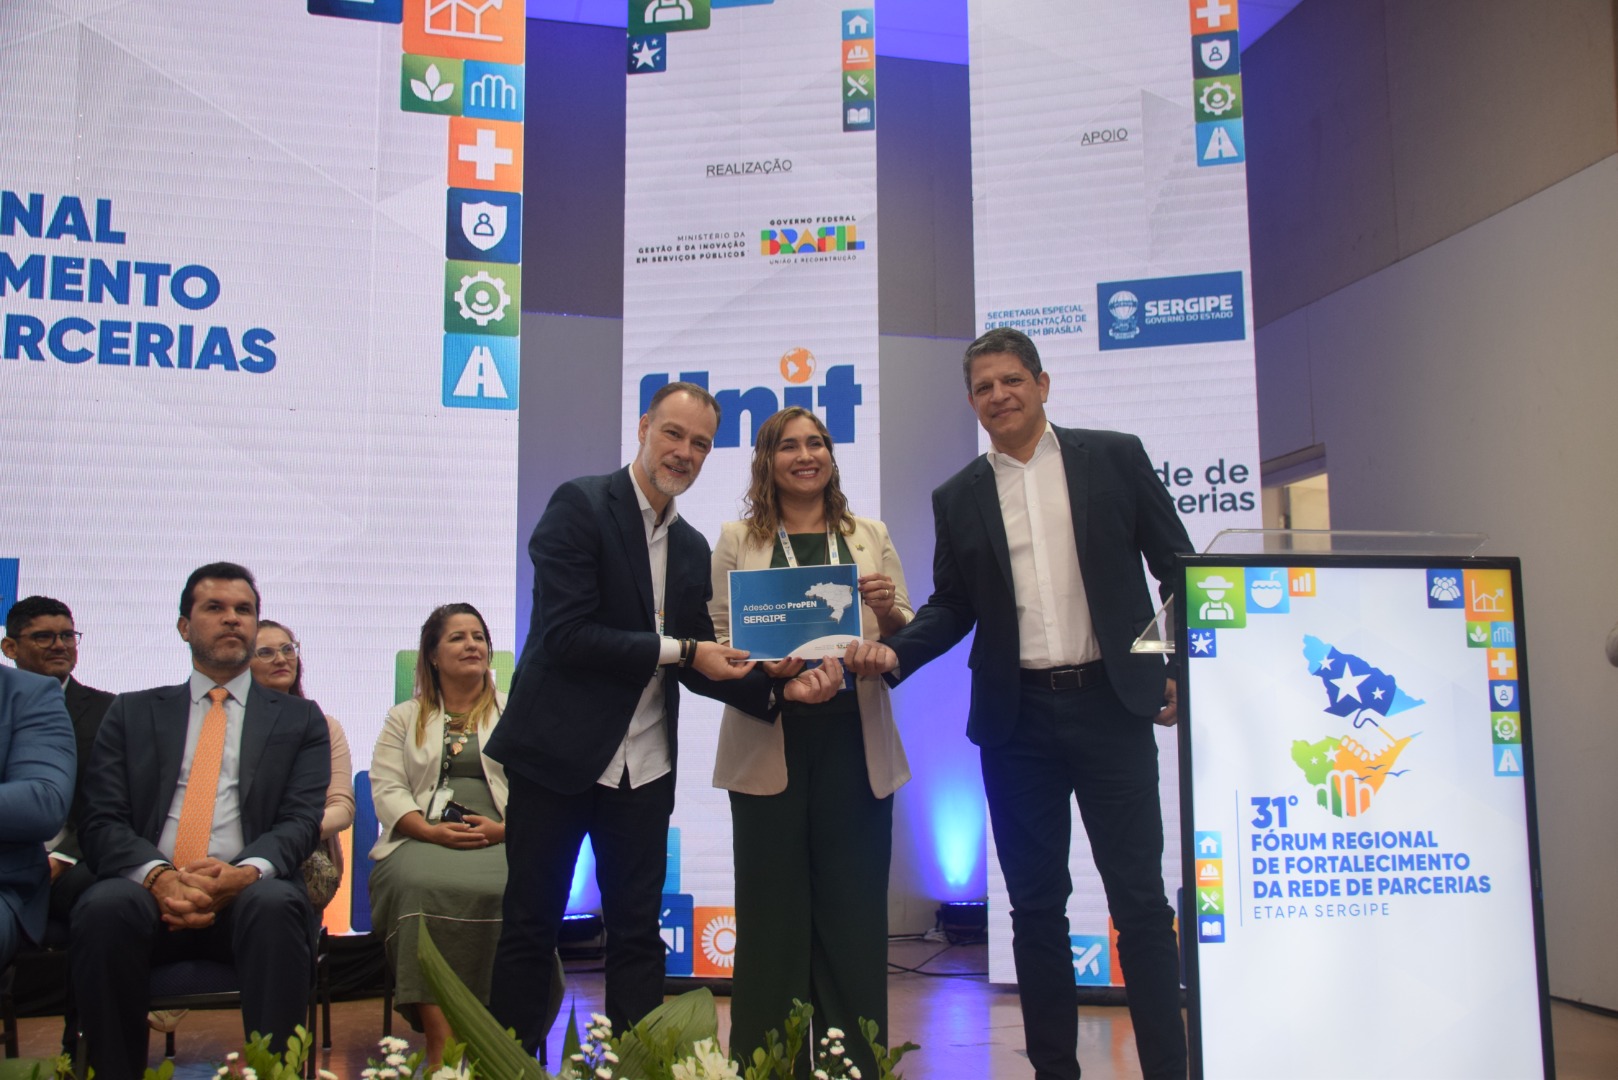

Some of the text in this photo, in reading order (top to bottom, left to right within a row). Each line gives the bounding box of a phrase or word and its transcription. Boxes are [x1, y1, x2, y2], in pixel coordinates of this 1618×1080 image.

[1081, 128, 1128, 146] APOIO
[706, 158, 792, 177] REALIZAÇÃO
[770, 218, 812, 226] GOVERNO
[677, 232, 730, 241] MINISTÉRIO
[761, 225, 865, 256] BRASIL
[638, 244, 672, 253] GESTÃO
[700, 240, 745, 249] INOVAÇÃO
[652, 254, 696, 262] SERVIÇOS
[700, 251, 745, 259] PÚBLICOS
[801, 255, 857, 263] RECONSTRUÇÃO
[987, 304, 1083, 319] SECRETARIA ESPECIAL
[1145, 295, 1233, 317] SERGIPE
[985, 322, 997, 330] DE
[1075, 314, 1087, 322] DE
[1145, 316, 1185, 325] GOVERNO
[1201, 311, 1233, 319] ESTADO
[1028, 329, 1040, 337] EM
[1043, 325, 1083, 336] BRASÍLIA
[0, 313, 277, 373] RCERIAS
[1205, 458, 1249, 485] de
[1171, 486, 1255, 514] erias
[743, 603, 773, 612] Adesão
[787, 601, 817, 609] ProPEN
[743, 614, 787, 624] SERGIPE
[1251, 829, 1438, 852] FÓRUM REGIONAL
[1252, 852, 1470, 875] DE FORTALECIMENTO
[1253, 875, 1491, 899] DA REDE DE PARCERIAS
[1254, 903, 1390, 919] ETAPA SERGIPE
